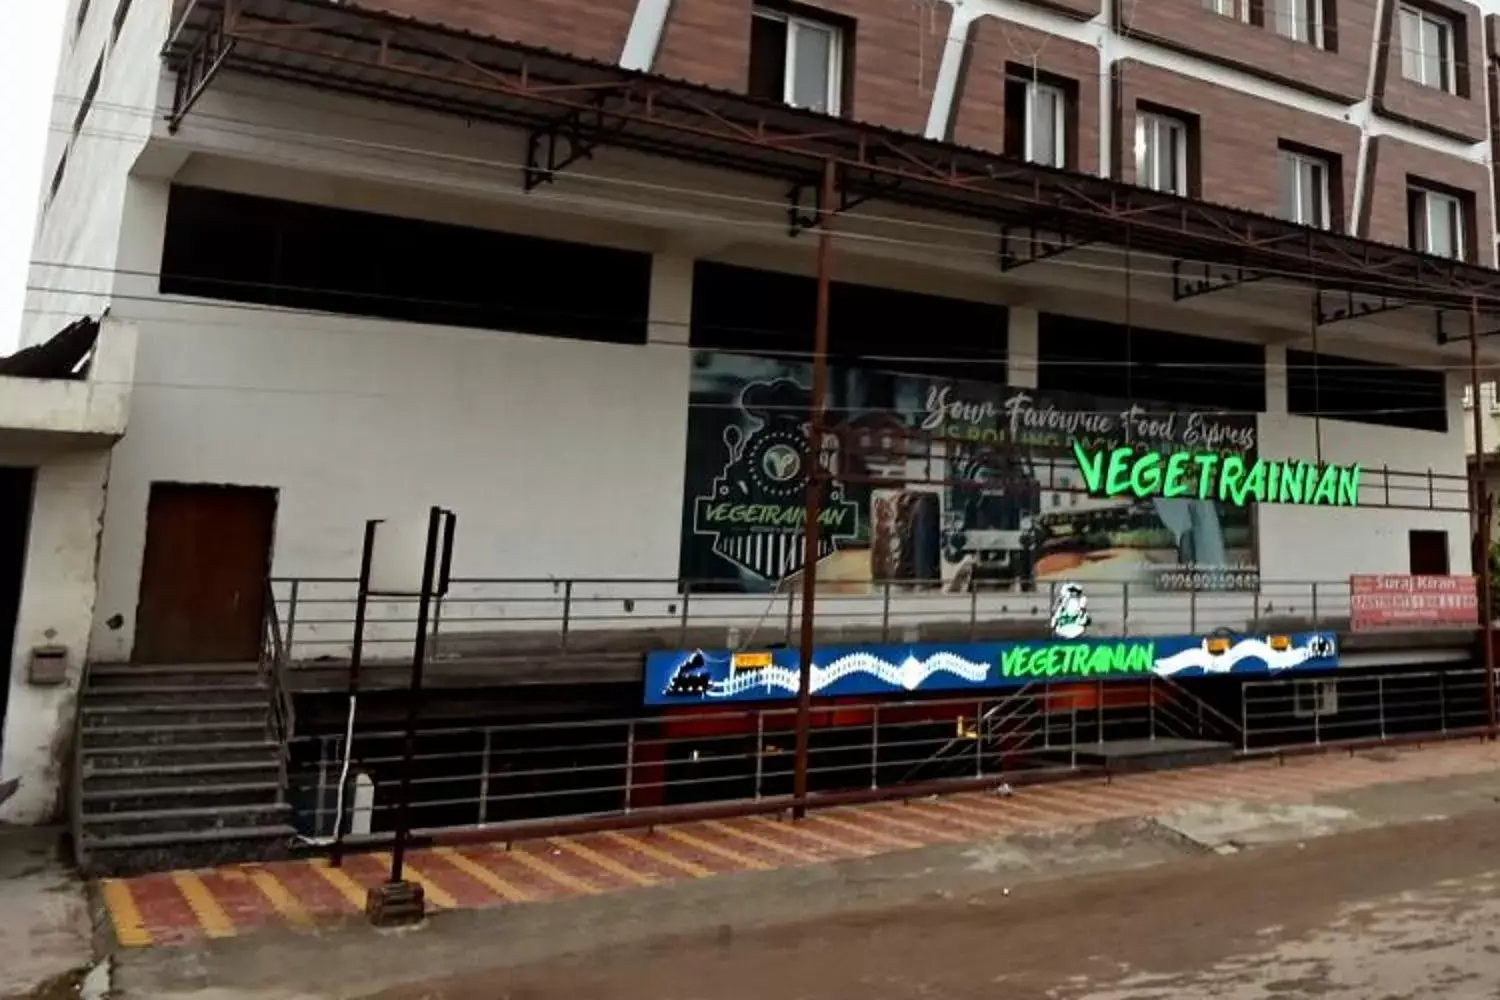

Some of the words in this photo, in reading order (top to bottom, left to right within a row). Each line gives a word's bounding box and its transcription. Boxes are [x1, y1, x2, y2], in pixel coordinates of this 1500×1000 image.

[921, 386, 994, 430] Your
[1120, 404, 1175, 445] Food
[1183, 412, 1256, 450] Express
[1074, 440, 1360, 506] VEGETRAINIAN
[705, 503, 848, 525] VEGETRAINAN
